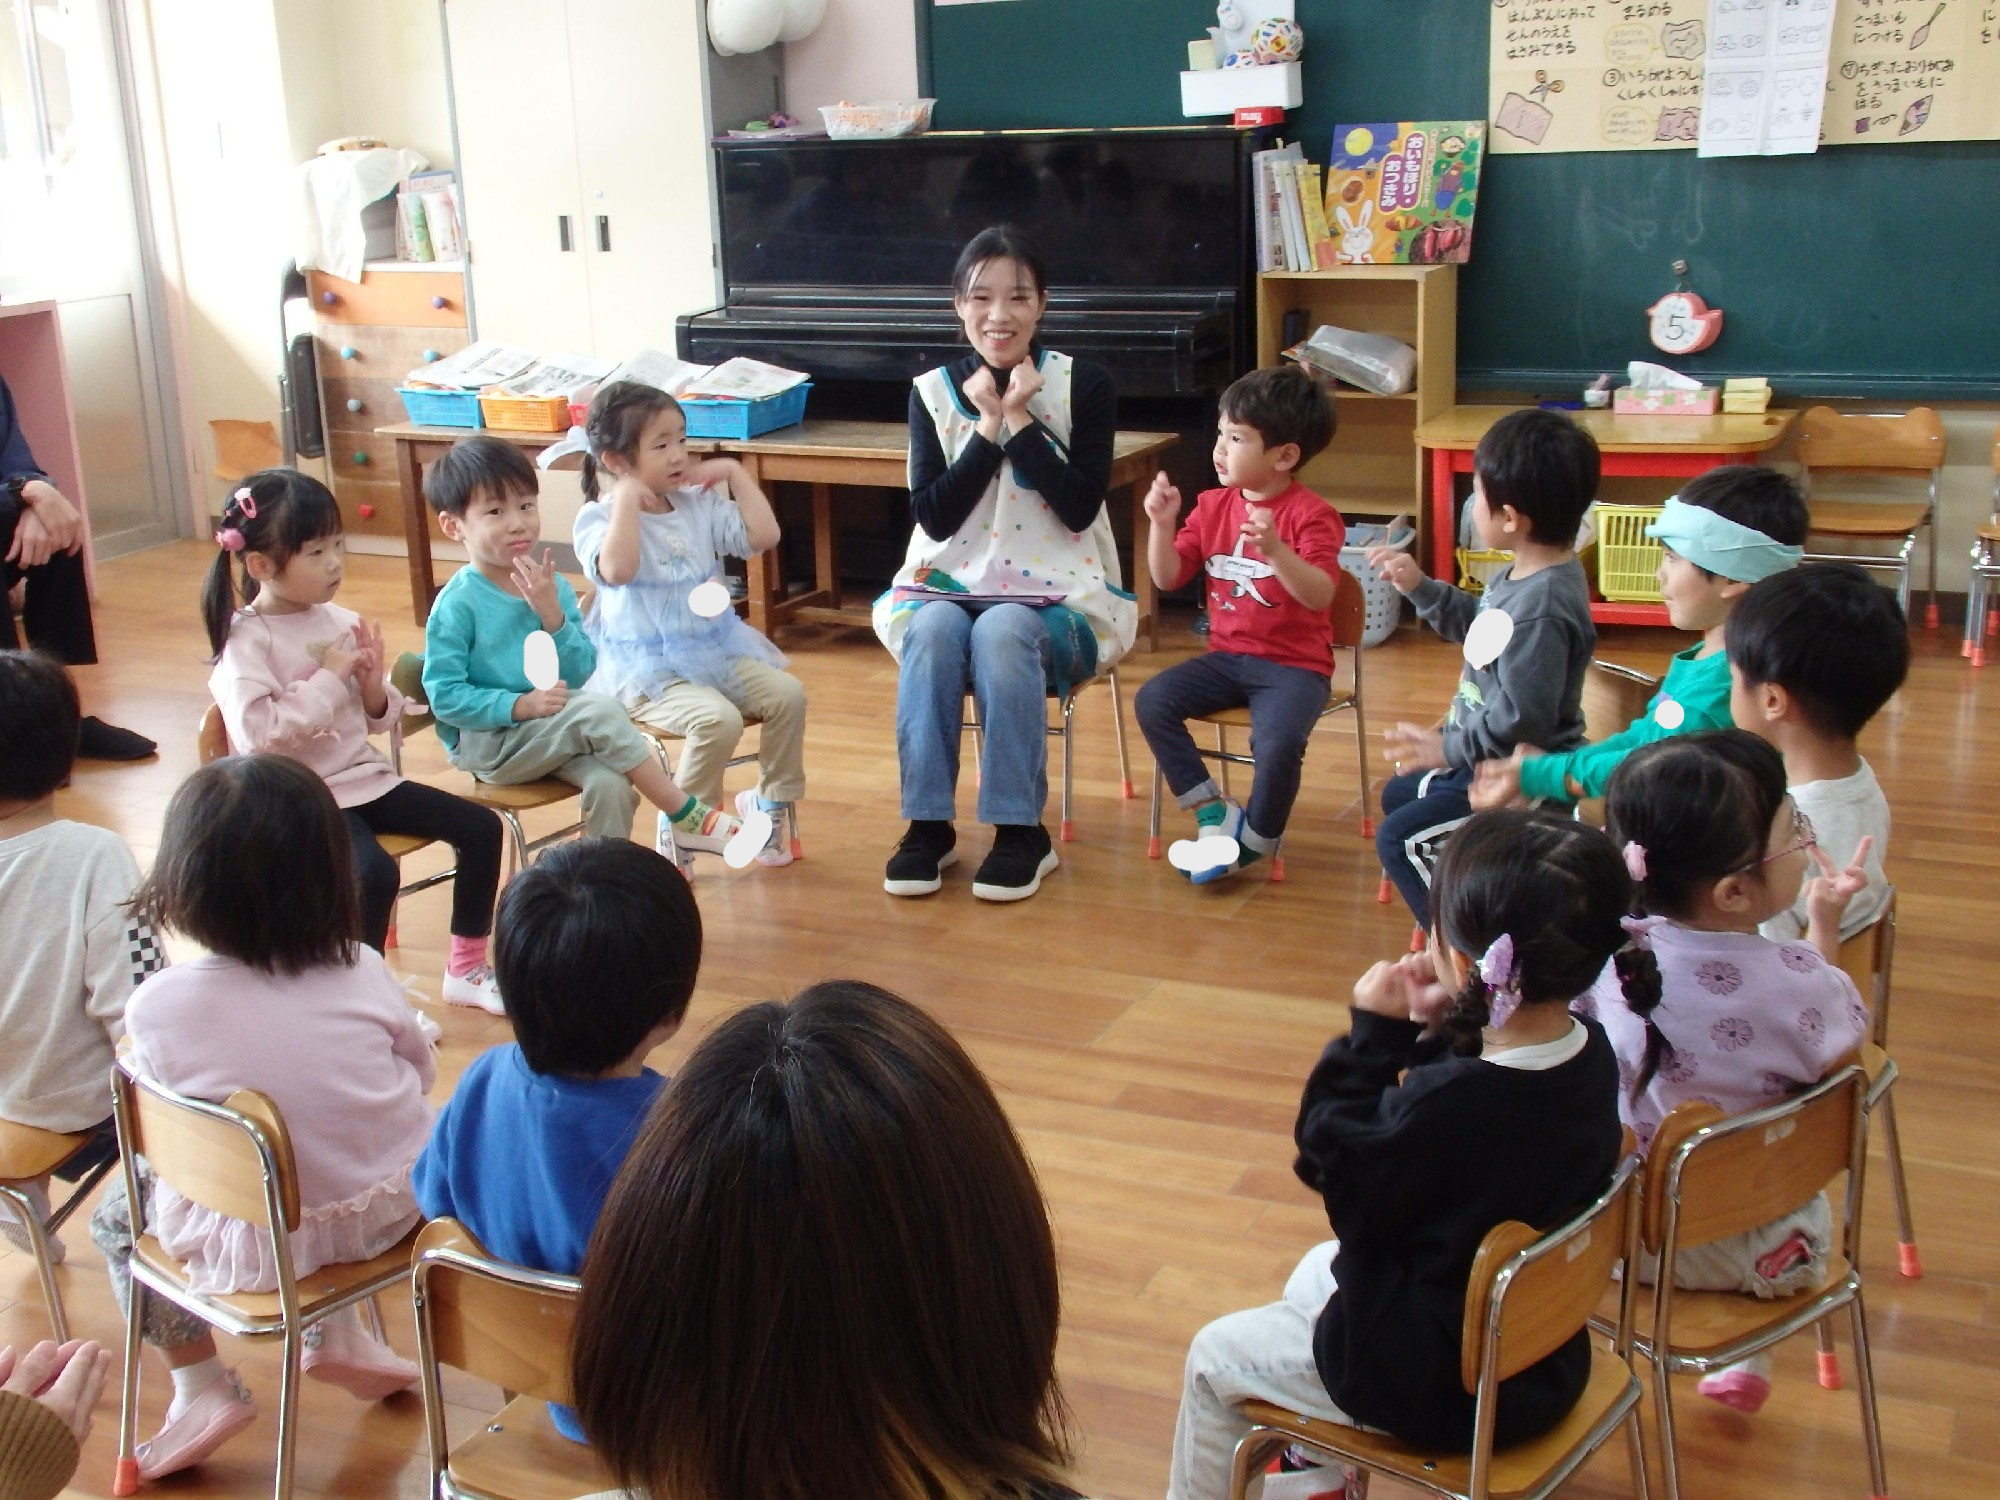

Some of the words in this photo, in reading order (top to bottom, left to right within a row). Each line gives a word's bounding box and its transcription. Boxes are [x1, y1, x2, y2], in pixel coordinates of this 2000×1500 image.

[1618, 85, 1704, 101] くしゃくしゃにす
[1380, 160, 1402, 207] おつきみ
[1666, 314, 1686, 341] 5
